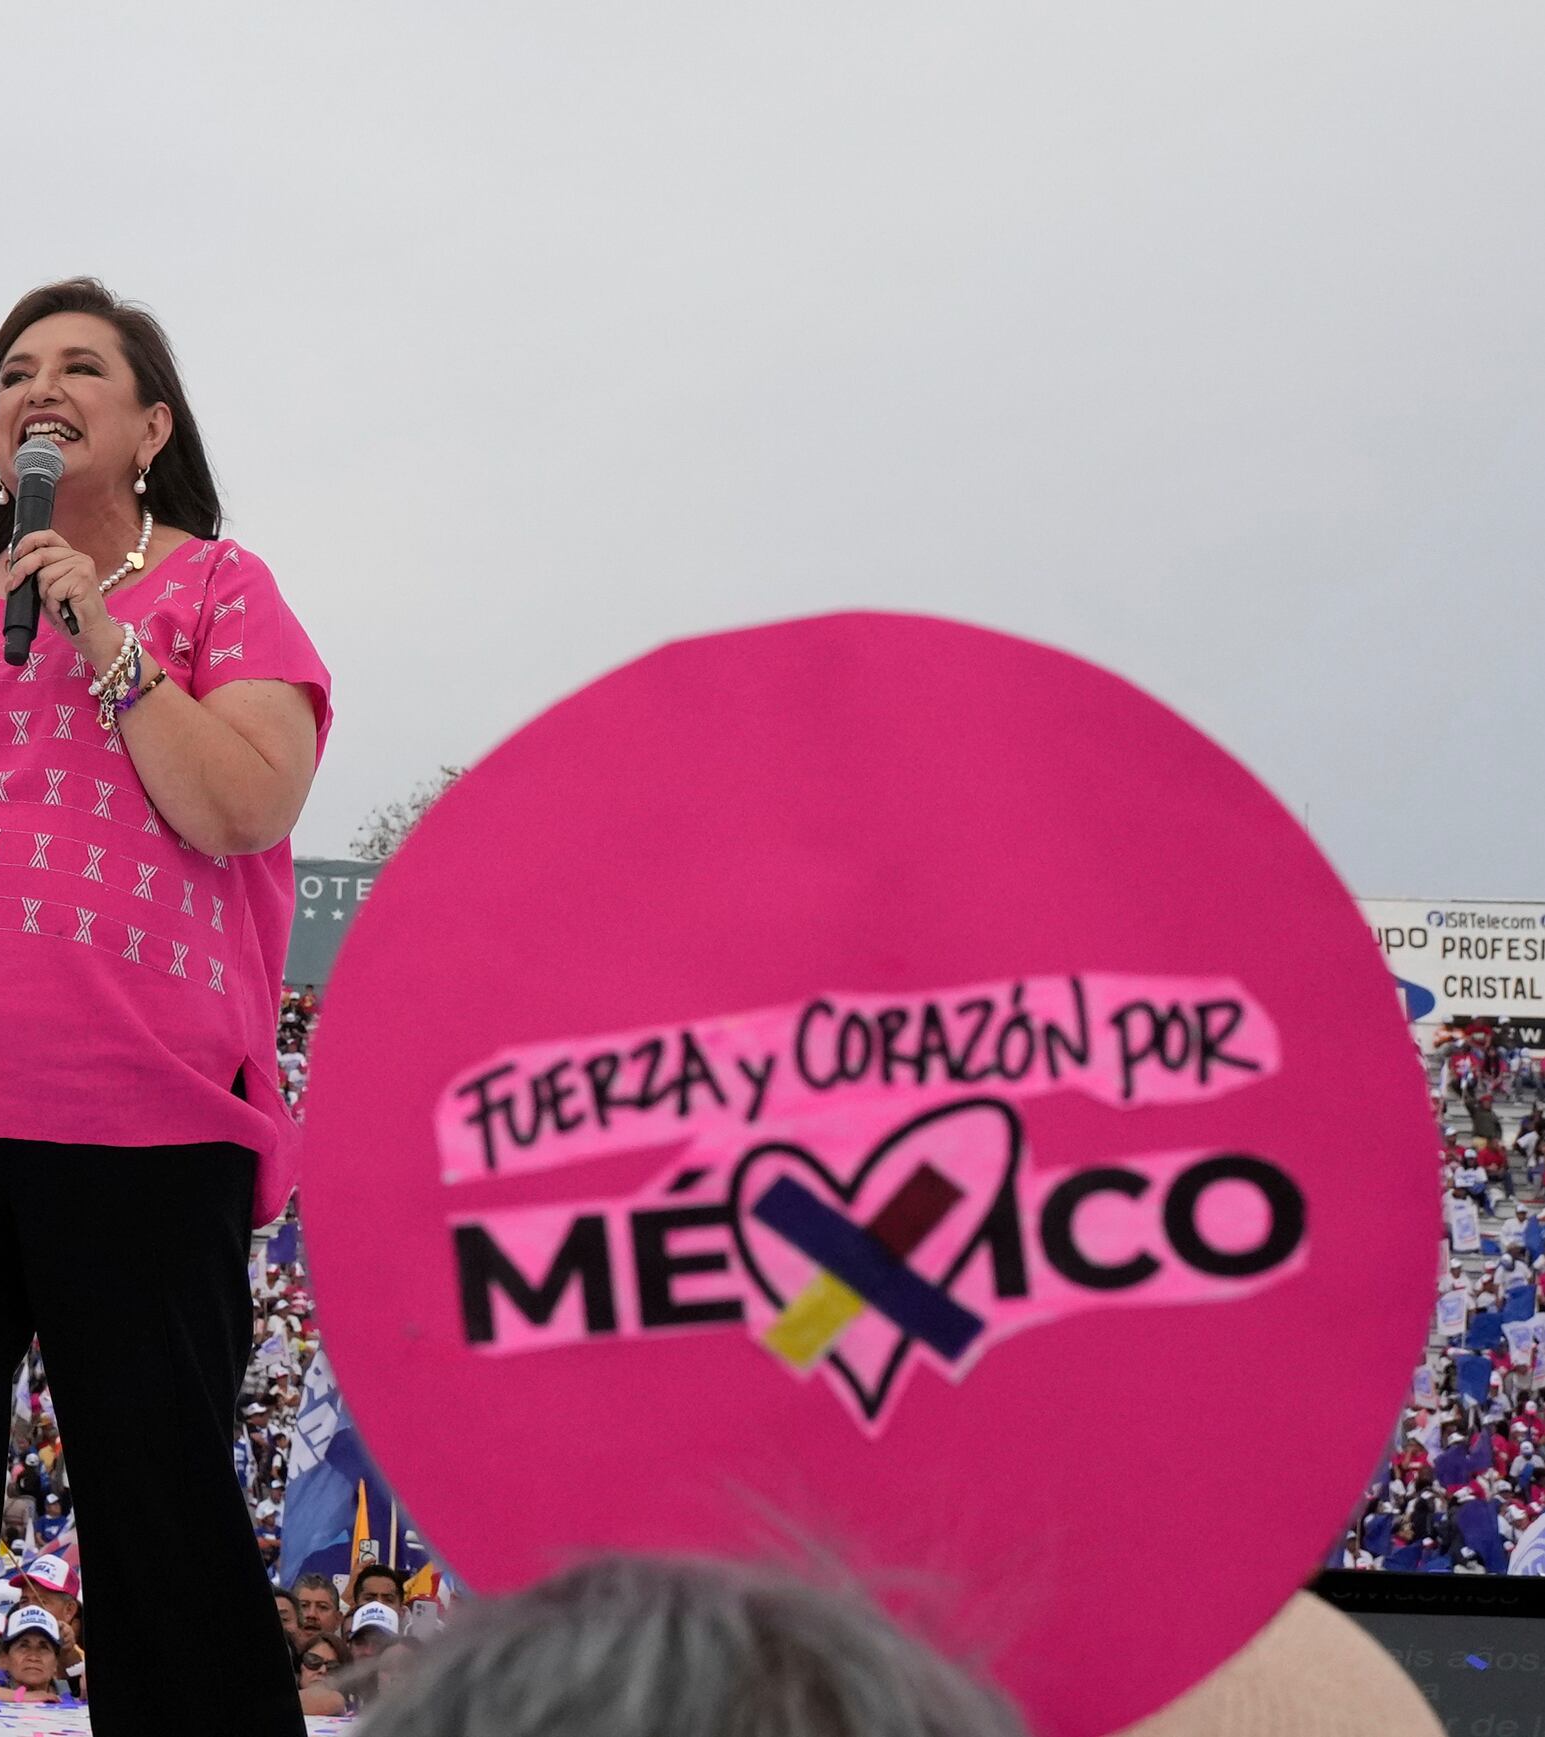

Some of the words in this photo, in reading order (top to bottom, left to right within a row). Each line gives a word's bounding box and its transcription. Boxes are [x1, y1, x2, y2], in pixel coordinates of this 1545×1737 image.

[1443, 975, 1543, 1000] CRISTAL
[455, 1031, 725, 1169] FUERZA
[796, 976, 1091, 1090] CORAZÓN
[1112, 998, 1263, 1100] POR
